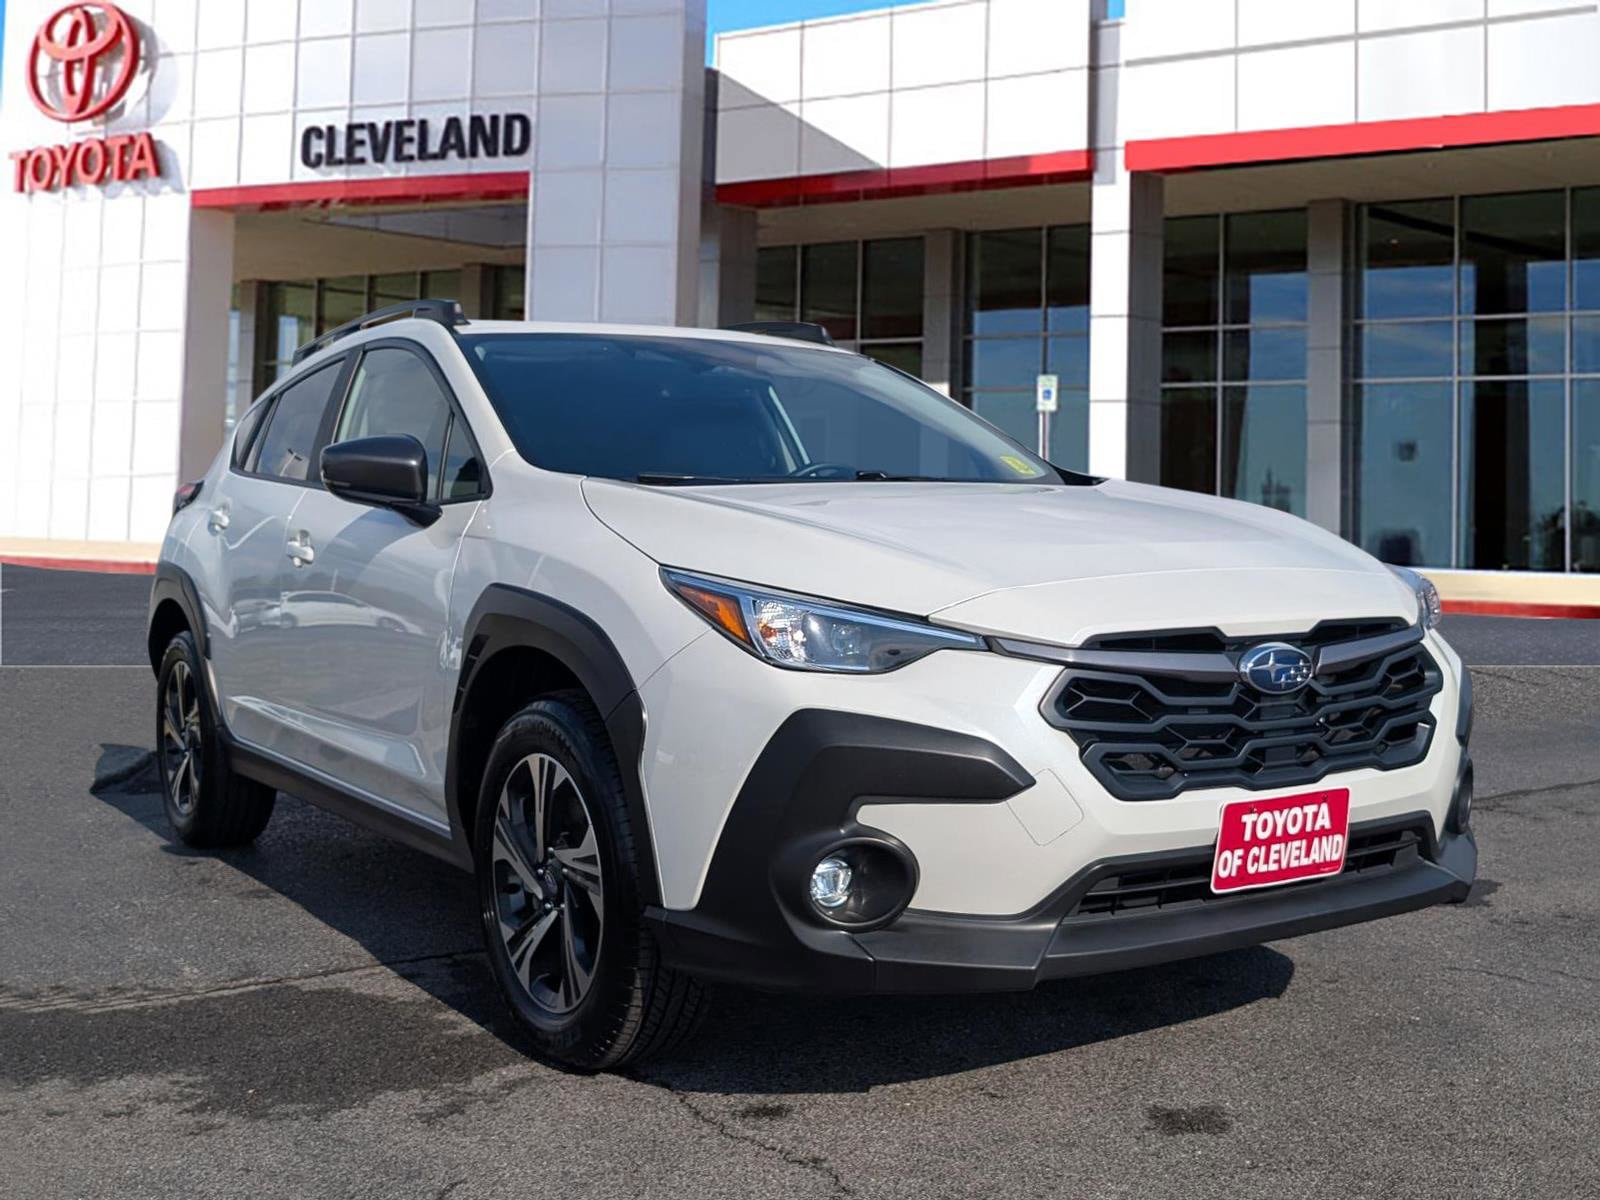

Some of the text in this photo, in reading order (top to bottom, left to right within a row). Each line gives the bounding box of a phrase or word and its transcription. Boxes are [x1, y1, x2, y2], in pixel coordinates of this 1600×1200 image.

[9, 132, 162, 193] TOYOTA
[301, 113, 531, 169] CLEVELAND
[1241, 802, 1331, 841] TOYOTA
[1217, 834, 1344, 878] OF CLEVELAND
